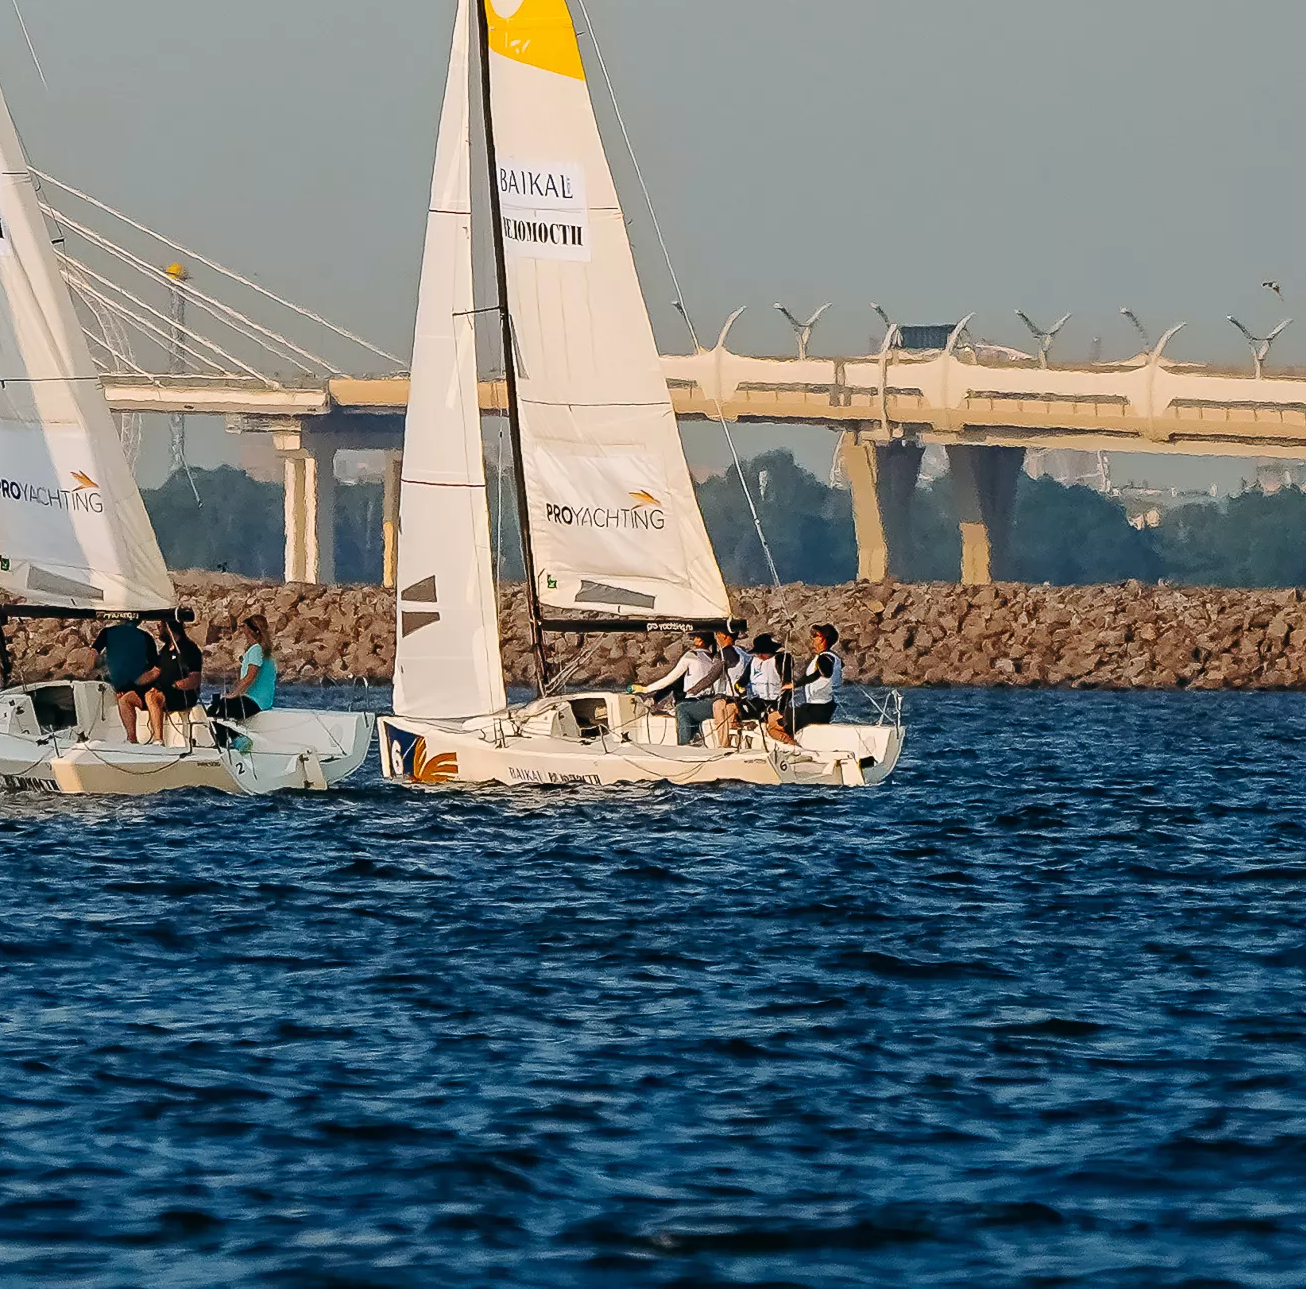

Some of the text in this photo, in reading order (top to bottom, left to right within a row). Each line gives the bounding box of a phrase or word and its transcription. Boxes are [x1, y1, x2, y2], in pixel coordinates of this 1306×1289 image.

[500, 167, 574, 199] BAIKAL
[546, 502, 665, 530] PROYACHTING
[235, 762, 246, 775] 2
[779, 760, 788, 772] 6
